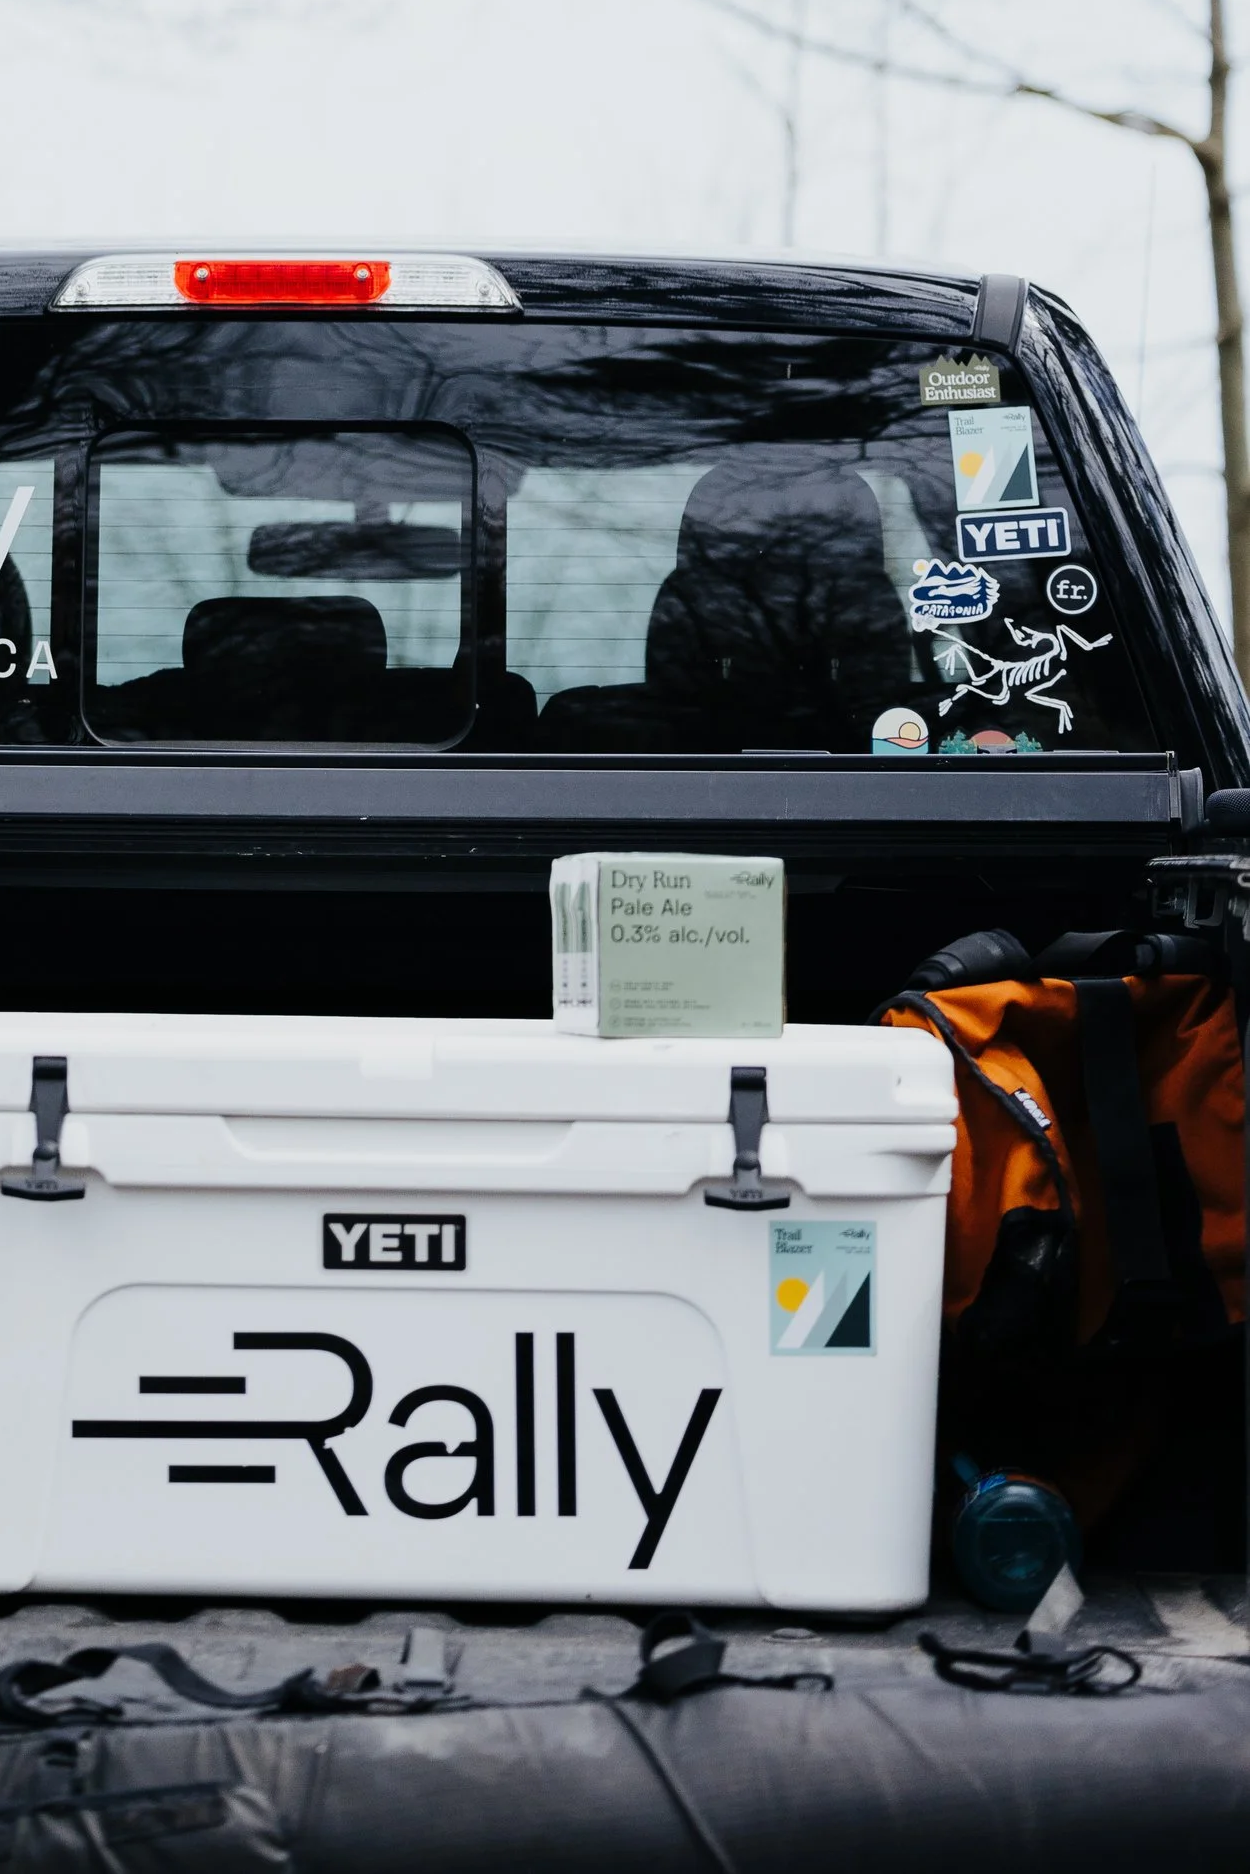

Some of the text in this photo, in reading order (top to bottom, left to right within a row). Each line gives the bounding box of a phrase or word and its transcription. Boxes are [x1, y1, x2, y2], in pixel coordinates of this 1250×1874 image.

[928, 371, 990, 386] Outdoor
[925, 385, 997, 401] Enthusiast
[955, 416, 975, 427] Trail
[956, 426, 983, 436] Blazer
[964, 518, 1059, 552] YETI
[1056, 579, 1088, 600] fr.
[921, 602, 984, 617] PATAGONIA
[611, 870, 691, 892] Dry Run
[730, 871, 774, 889] Rally
[611, 897, 693, 916] Pale Ale
[610, 924, 661, 944] 0.3%
[668, 925, 751, 947] alc./vol.
[329, 1223, 456, 1263] YETI
[775, 1228, 802, 1241] Trail
[72, 1332, 723, 1570] Rally
